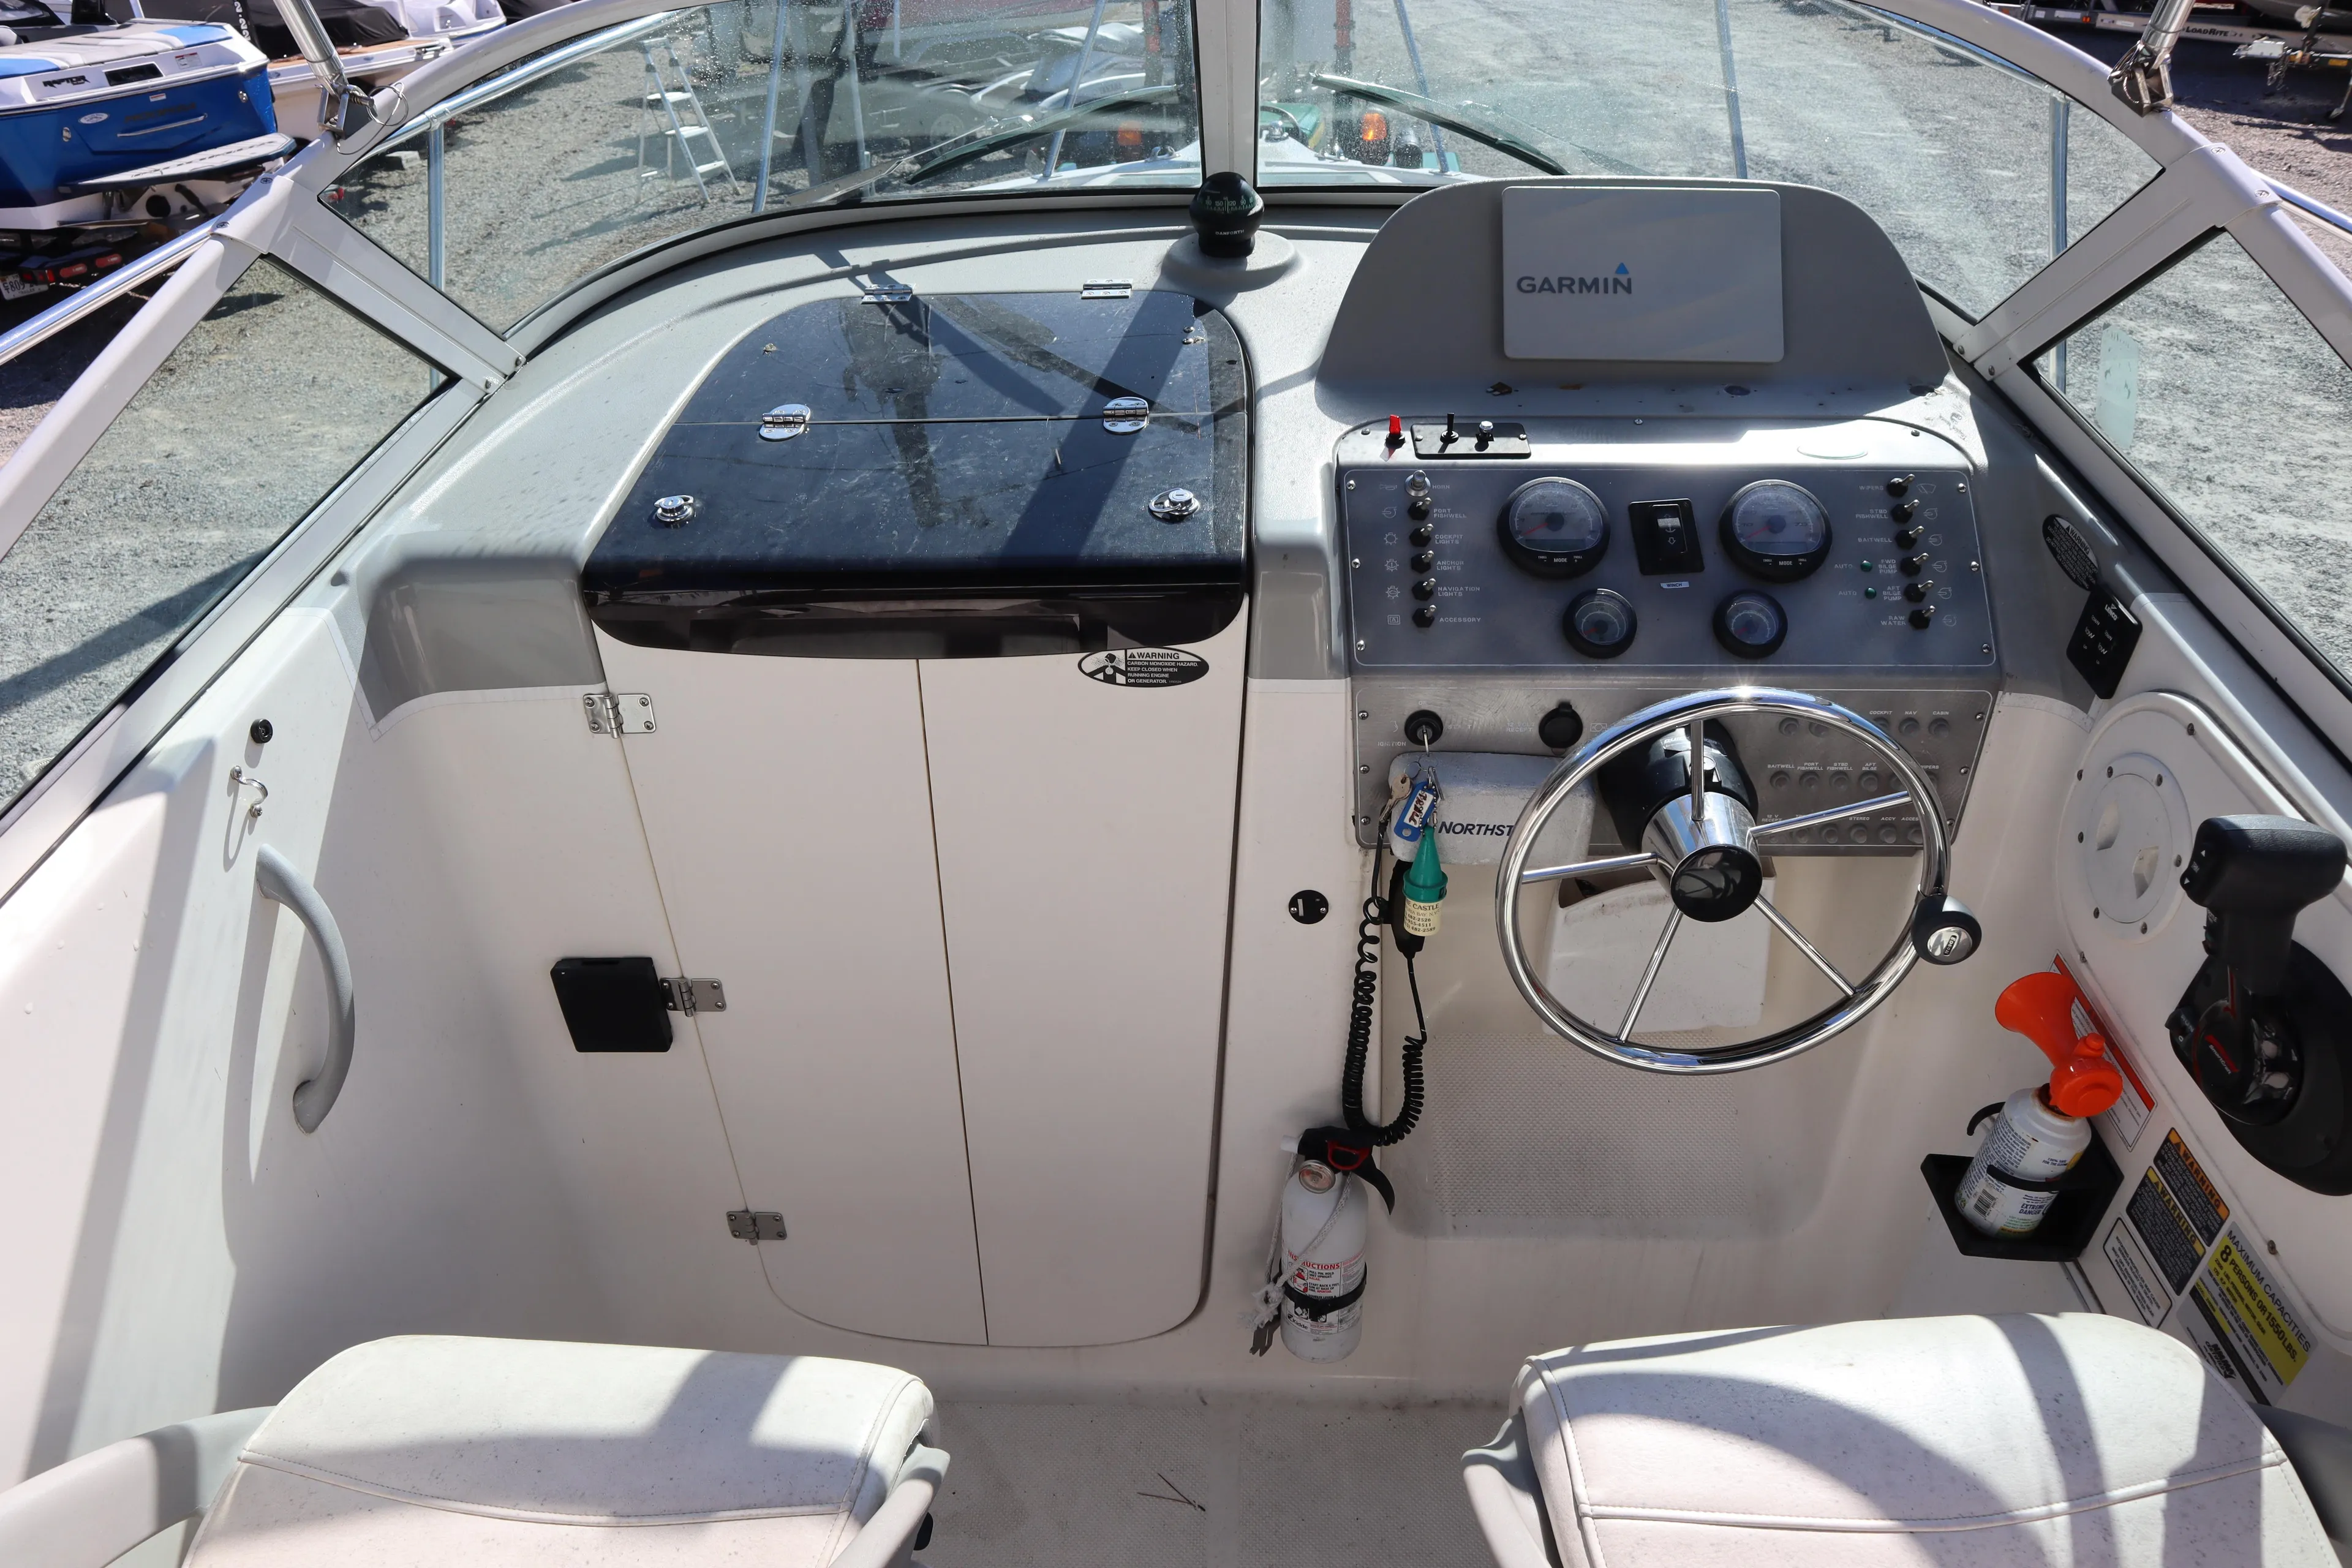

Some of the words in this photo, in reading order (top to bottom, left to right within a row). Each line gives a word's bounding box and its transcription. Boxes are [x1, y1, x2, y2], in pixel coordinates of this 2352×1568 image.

[1517, 276, 1632, 295] GARMIN
[2068, 528, 2090, 556] WARNING
[1438, 821, 1515, 837] NORTHST
[1944, 937, 1956, 954] EDSON
[2181, 1149, 2222, 1210] WARNING
[2159, 1187, 2197, 1246] WARNING
[2218, 1242, 2233, 1265] 8
[2227, 1257, 2260, 1303] PERSONS
[2255, 1298, 2268, 1316] OR
[2263, 1310, 2286, 1342] 1550
[2280, 1336, 2300, 1363] LBS.
[2225, 1229, 2265, 1286] MAXIMUM
[2261, 1282, 2312, 1354] CAPACITIES
[1292, 1320, 1308, 1330] Kidde
